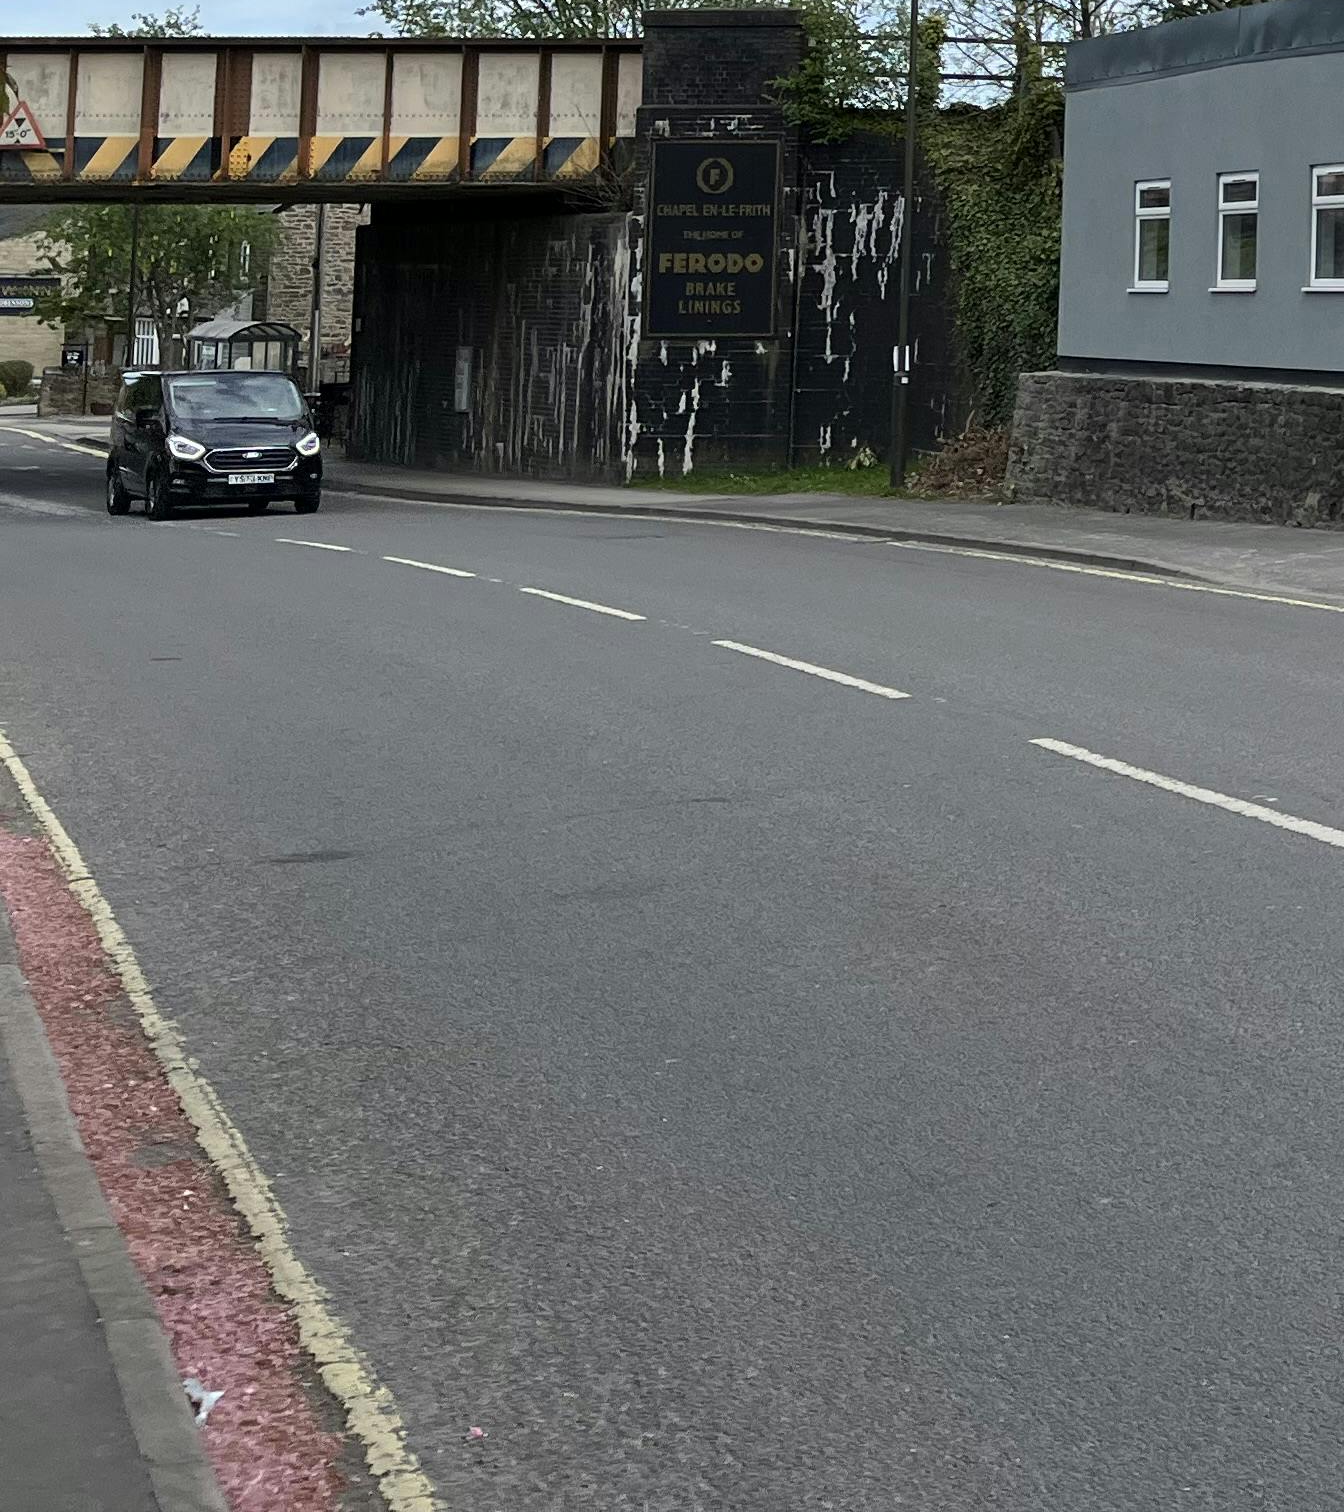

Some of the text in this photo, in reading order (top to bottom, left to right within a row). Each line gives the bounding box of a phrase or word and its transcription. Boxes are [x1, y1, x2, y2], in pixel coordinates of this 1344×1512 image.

[709, 168, 720, 185] F
[656, 204, 771, 217] CHAPEL EN-LE-FRITH
[659, 253, 764, 273] FERODO
[685, 282, 736, 296] BRAKE
[678, 300, 741, 314] LININGS
